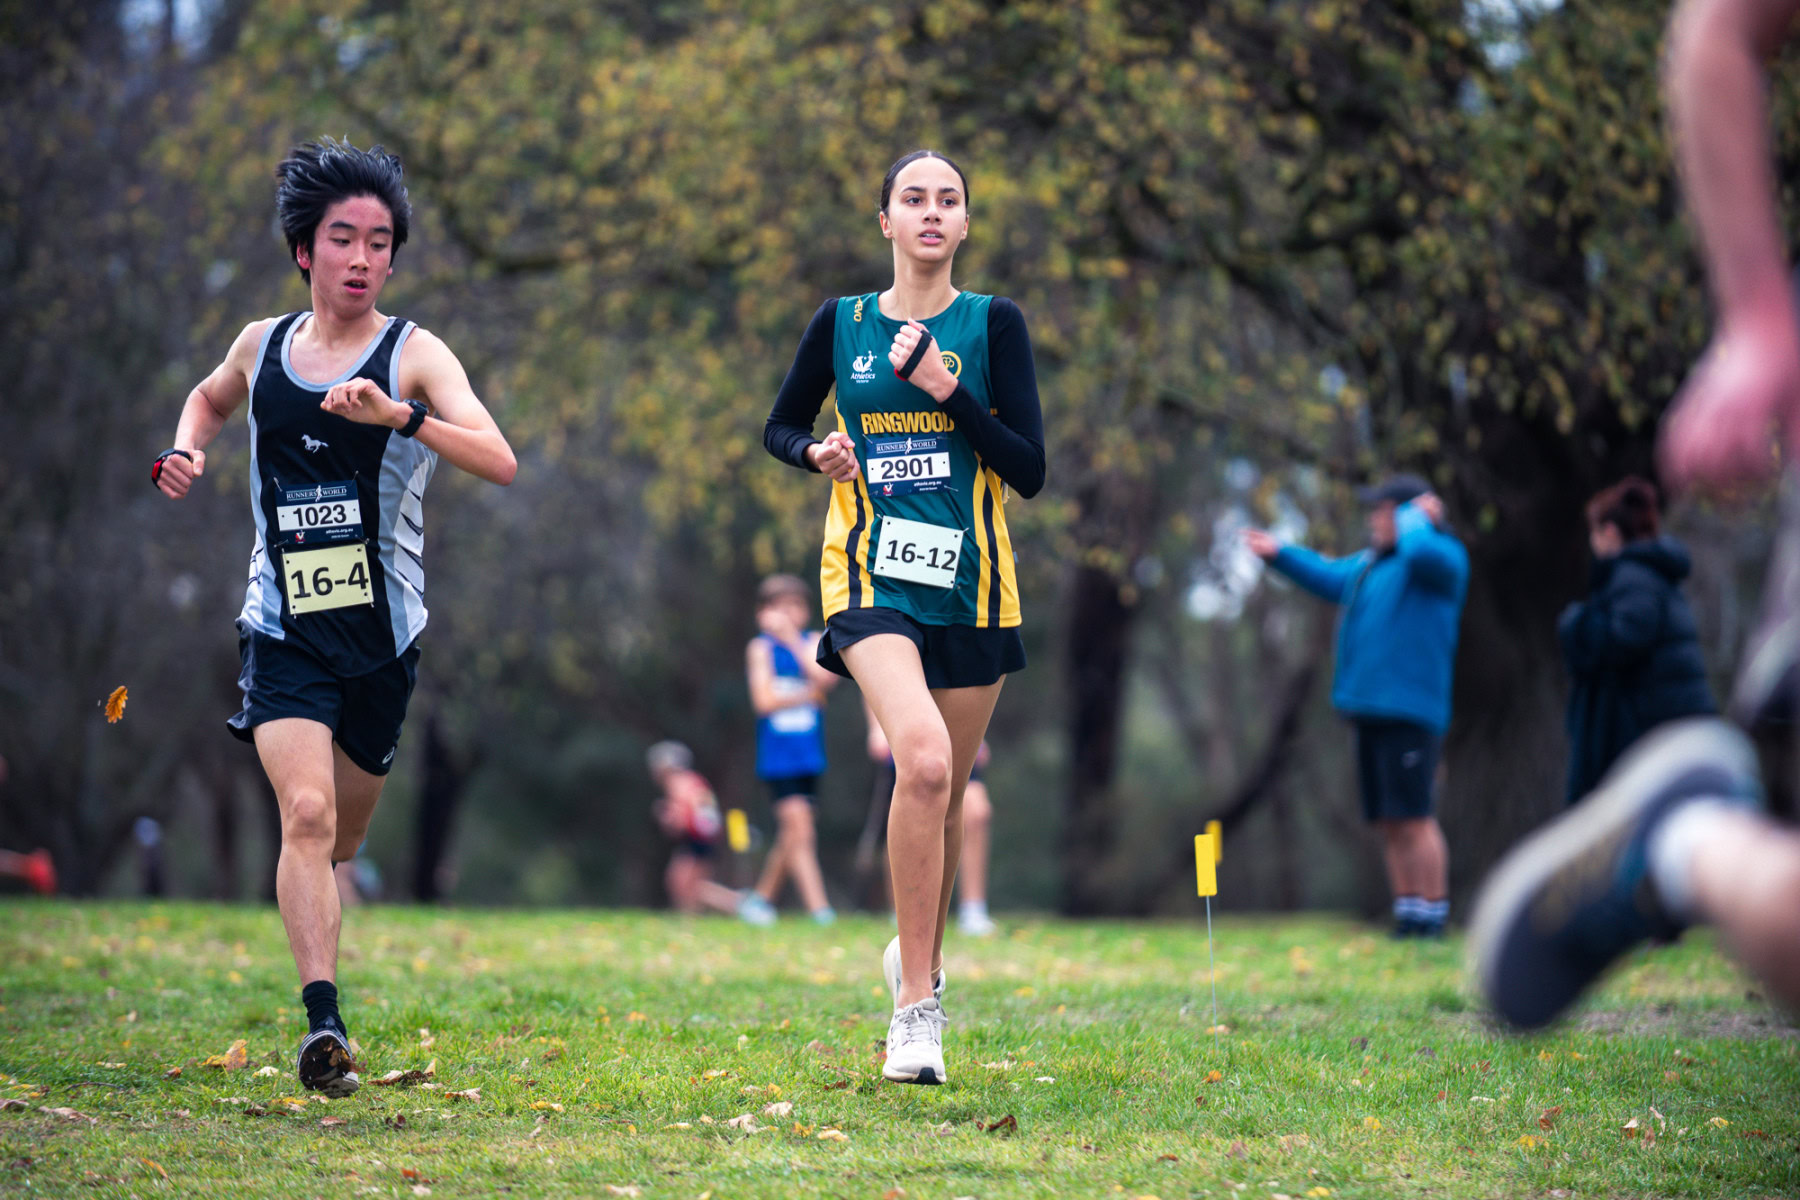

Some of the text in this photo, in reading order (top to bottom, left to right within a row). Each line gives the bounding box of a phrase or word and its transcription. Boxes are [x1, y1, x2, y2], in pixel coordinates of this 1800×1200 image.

[861, 411, 955, 434] RINGWOOD
[912, 440, 937, 449] WORLD
[881, 456, 933, 479] 2901
[286, 488, 347, 499] RUNNERS WORLD
[293, 504, 347, 526] 1023
[885, 539, 957, 571] 16-12
[291, 562, 369, 599] 16-4
